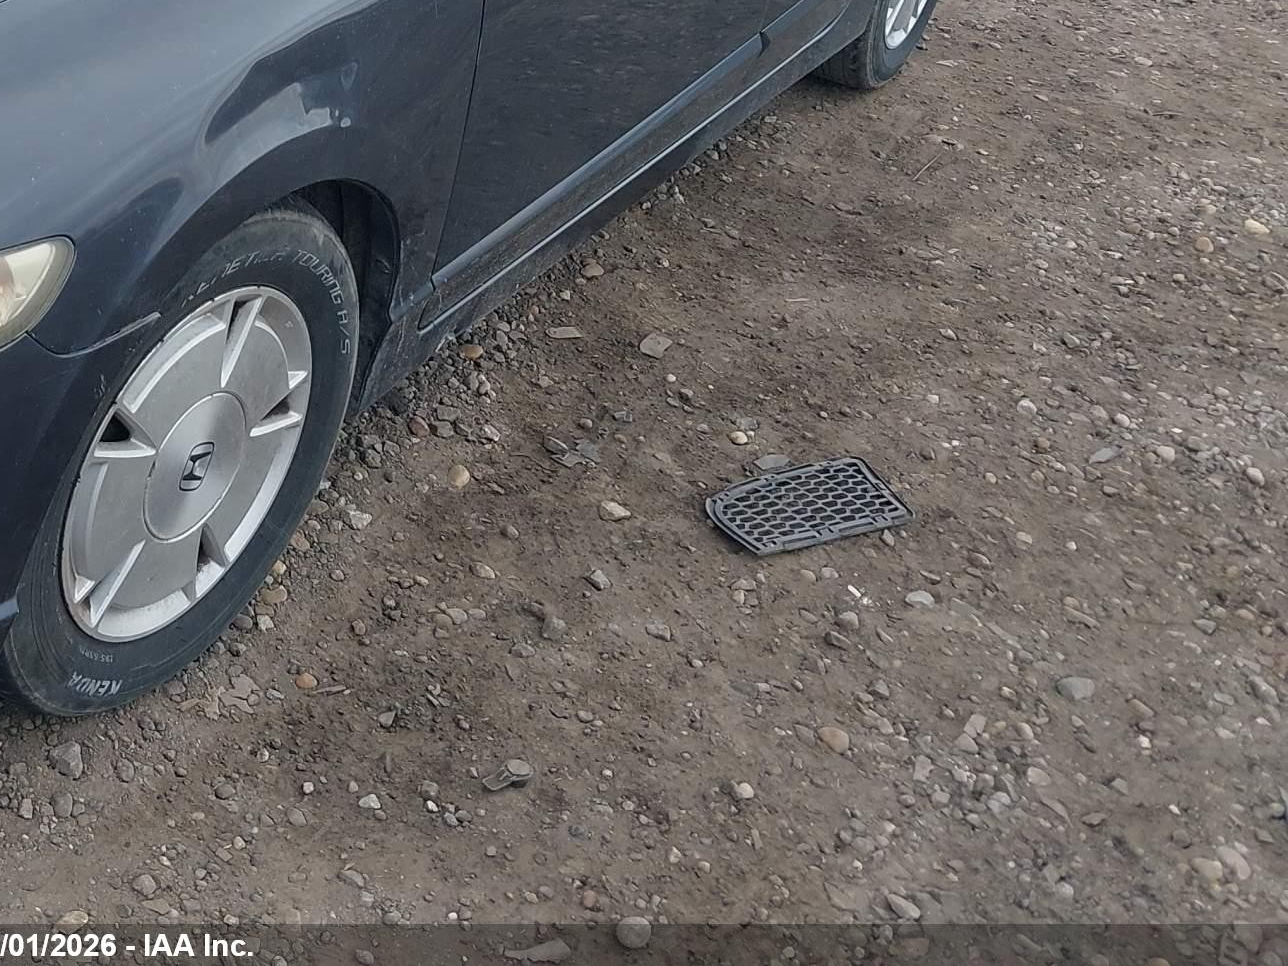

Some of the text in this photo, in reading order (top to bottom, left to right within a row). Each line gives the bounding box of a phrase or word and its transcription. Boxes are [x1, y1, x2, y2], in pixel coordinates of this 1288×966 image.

[291, 249, 351, 355] TOURING A/S
[67, 671, 123, 696] KENDA
